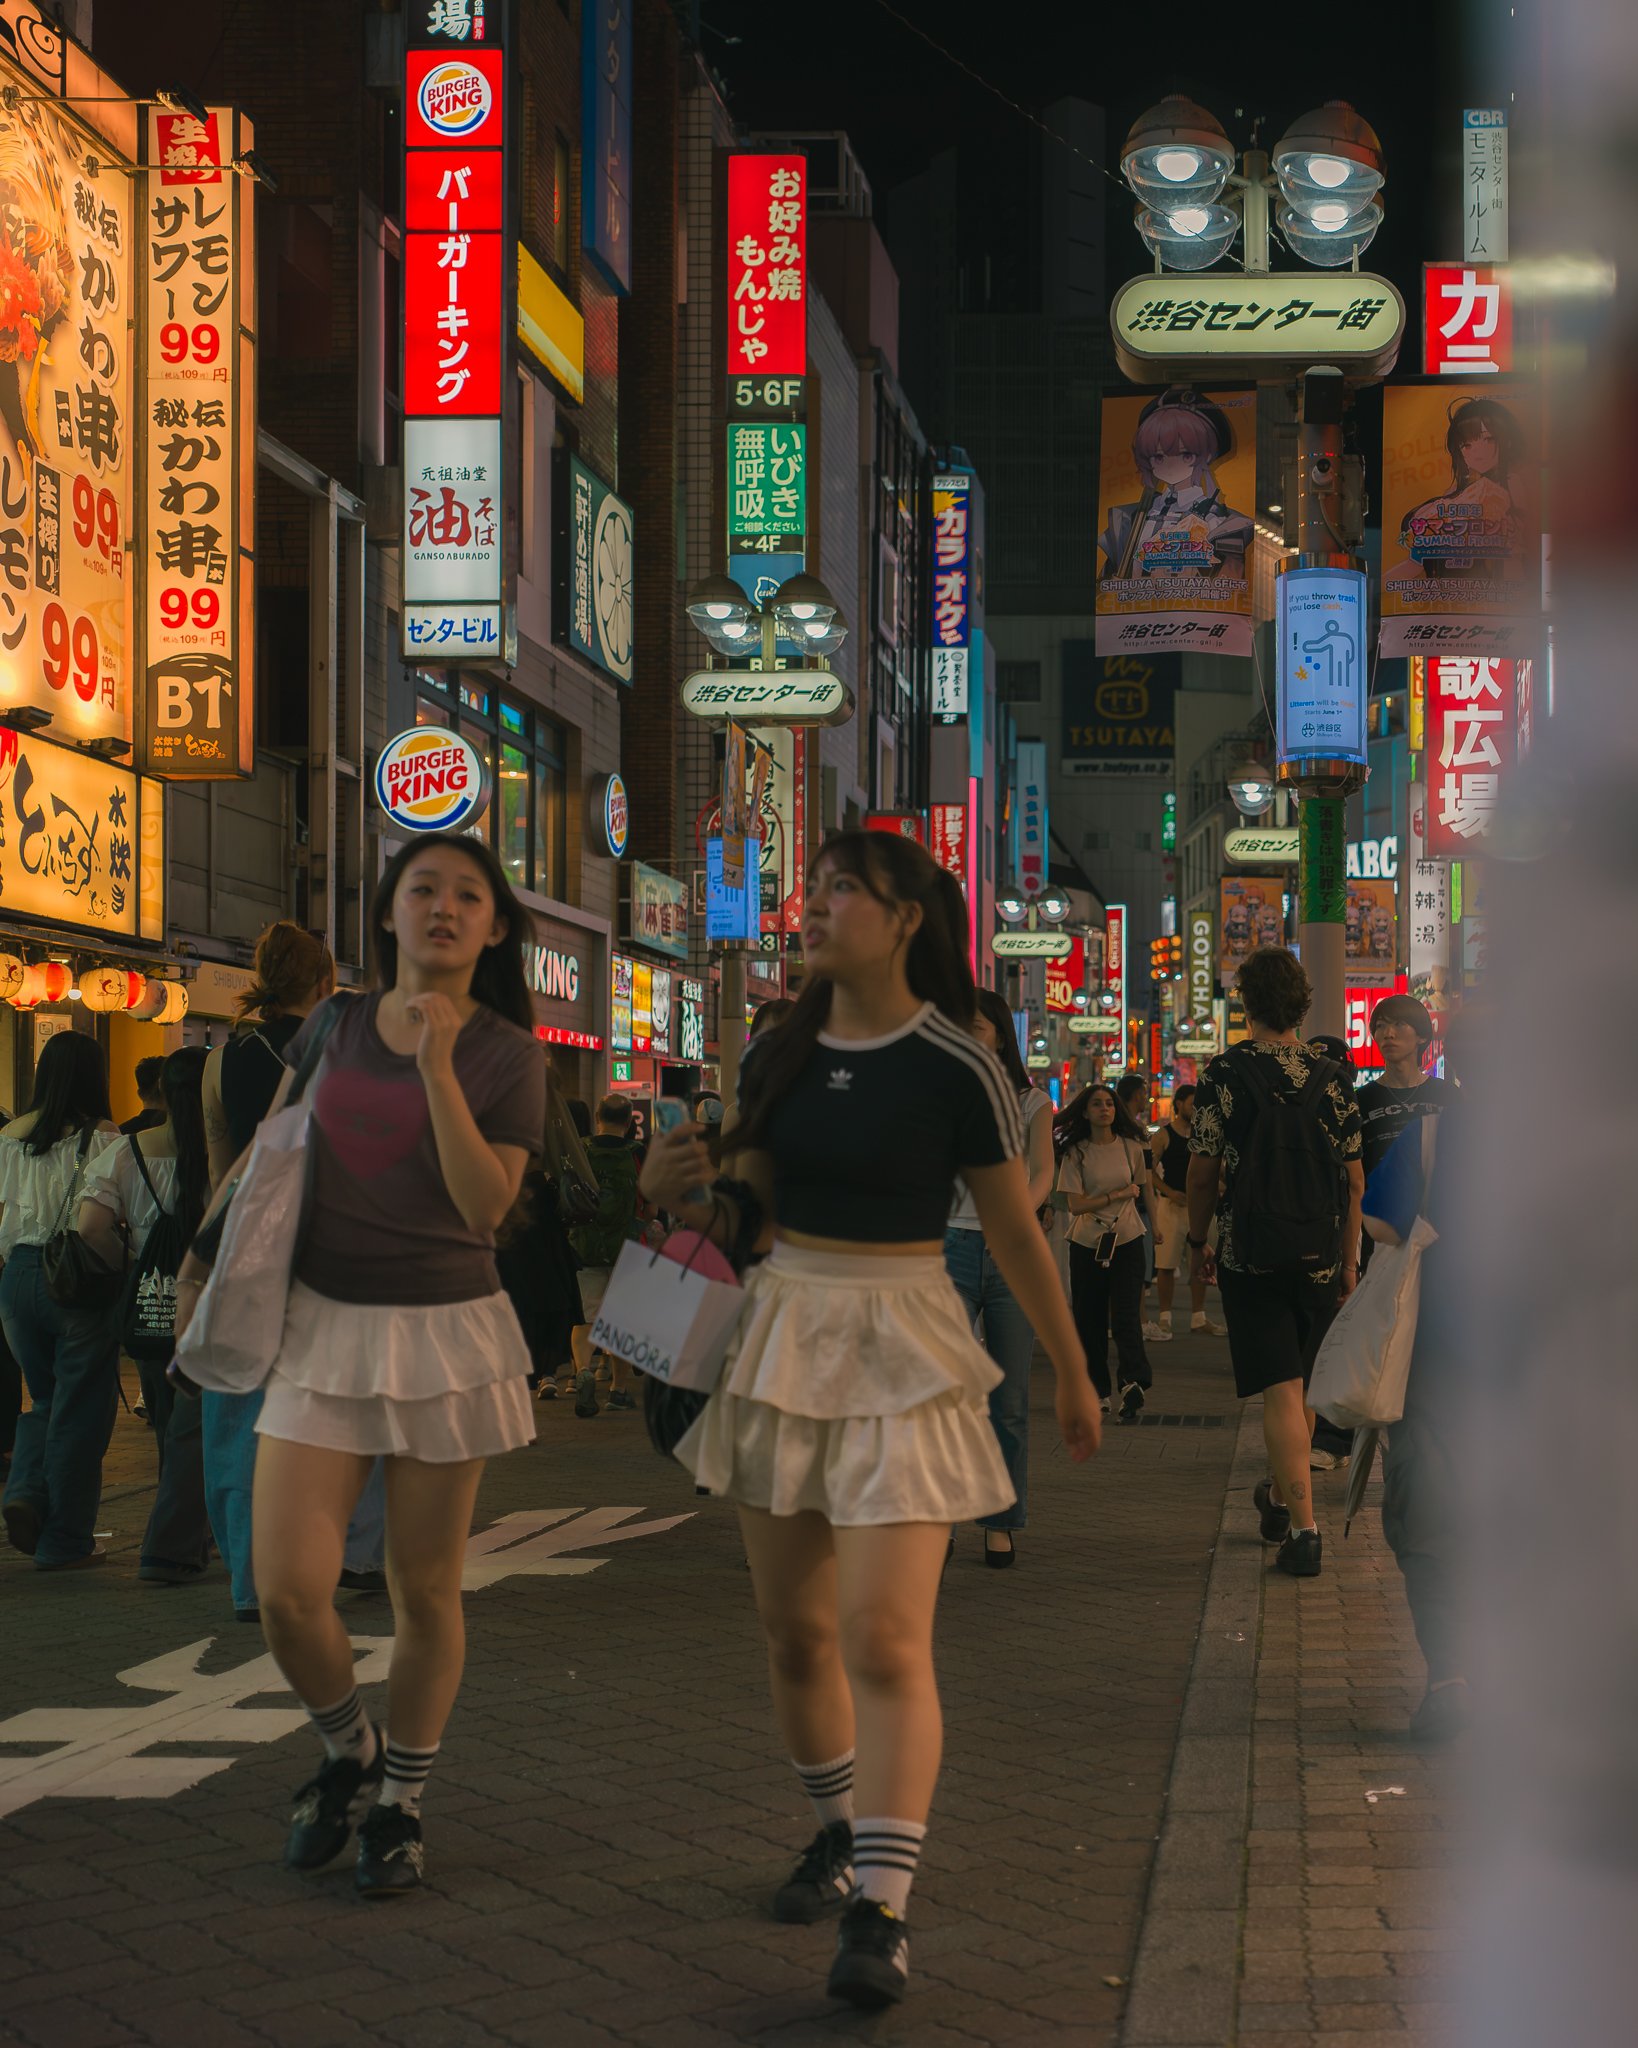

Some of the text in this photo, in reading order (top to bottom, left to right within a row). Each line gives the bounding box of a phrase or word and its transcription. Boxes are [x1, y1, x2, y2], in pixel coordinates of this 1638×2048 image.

[427, 76, 480, 103] BURGER
[429, 87, 483, 120] KING
[1467, 110, 1504, 126] CBR
[1491, 131, 1503, 210] 渋谷センター街
[1469, 132, 1488, 254] モニタールーム
[73, 180, 120, 249] 秘伝
[191, 186, 229, 317] レモン
[768, 168, 802, 301] お好み焼
[151, 195, 190, 321] サワー
[436, 165, 472, 404] バーガーキング
[734, 234, 768, 365] もんじゃ
[1126, 297, 1388, 332] 渋谷センター街
[76, 243, 121, 471] かわ串
[159, 322, 221, 365] 99
[212, 367, 228, 385] 円
[56, 402, 71, 439] 一本
[153, 397, 227, 429] 秘伝
[421, 465, 488, 482] 元祖油堂
[734, 427, 765, 519] 無呼吸
[770, 427, 802, 518] いびき
[72, 473, 120, 560] 99
[156, 433, 223, 579] かわ串
[409, 486, 472, 548] 油
[474, 497, 498, 547] そば
[734, 521, 801, 533] ご相談ください
[754, 535, 781, 552] 4F
[1413, 535, 1465, 548] SUMMER
[110, 551, 123, 581] 円
[414, 552, 490, 560] GANSO ABURADO
[935, 505, 967, 631] カラオケ
[1144, 552, 1179, 560] SUMMER
[1102, 577, 1249, 592] SHIBUYA TSUTAYA 6Fにて
[1295, 595, 1310, 603] you
[1311, 593, 1336, 601] throw
[1386, 579, 1439, 592] SHIBUYA
[159, 587, 220, 629] 99
[1289, 605, 1302, 614] you
[1303, 602, 1321, 610] lose
[210, 630, 225, 648] 円
[408, 617, 498, 643] センタービル
[1119, 621, 1230, 640] 渋谷センター街
[1403, 624, 1515, 641] 渋谷センター街
[42, 602, 99, 702] 99
[100, 676, 116, 712] 円
[691, 684, 837, 703] 渋谷センター街
[937, 652, 949, 709] ルノアール
[156, 675, 222, 729] B1
[942, 713, 958, 724] 2F
[1070, 726, 1175, 746] TSUTAYA
[1316, 723, 1342, 733] 渋谷区
[387, 747, 465, 784] BURGER
[1438, 656, 1503, 839] 歌広場
[389, 765, 468, 811] KING
[1347, 836, 1398, 879] ABC
[1415, 858, 1436, 945] 麻辣湯
[213, 969, 249, 990] SHIBUYA
[533, 946, 579, 1002] KING
[1193, 919, 1210, 1020] GOTCHA
[591, 1317, 673, 1379] PANDORA
